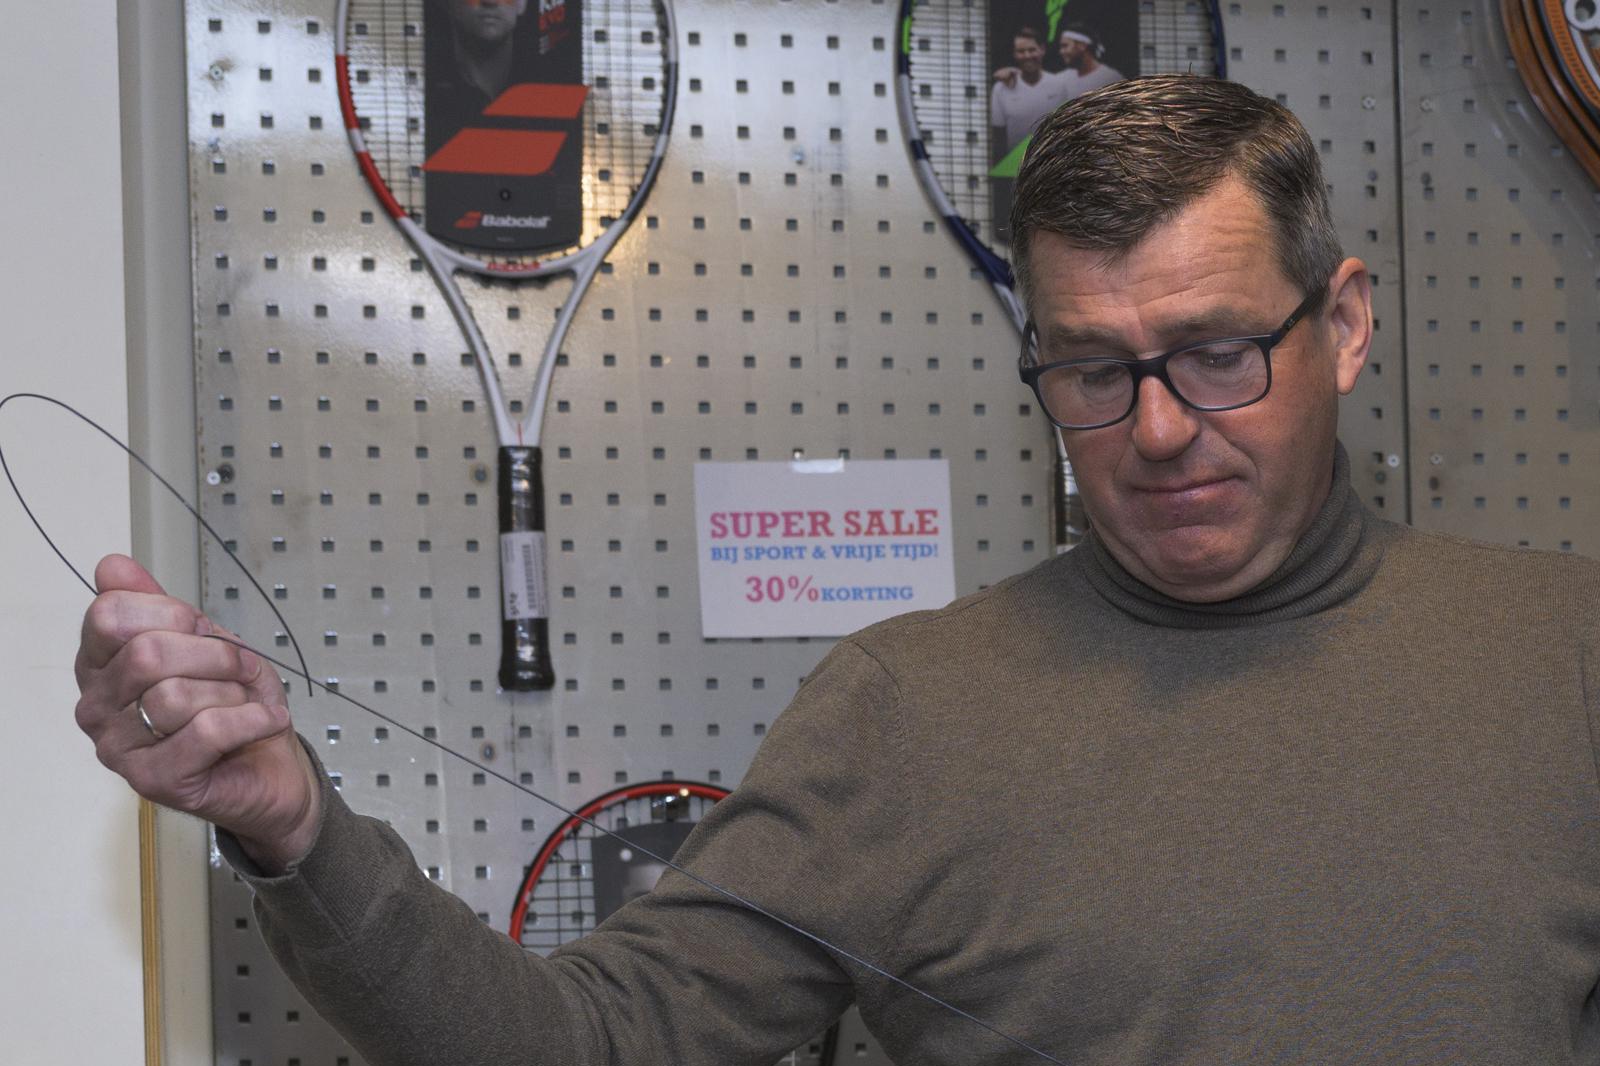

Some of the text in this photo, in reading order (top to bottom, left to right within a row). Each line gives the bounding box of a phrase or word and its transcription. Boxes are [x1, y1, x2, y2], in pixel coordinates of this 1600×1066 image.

[710, 509, 939, 539] SUPER SALE
[711, 543, 939, 564] BIJ SPORT & VRIJE TIJD!
[745, 575, 914, 603] 30% KORTING
